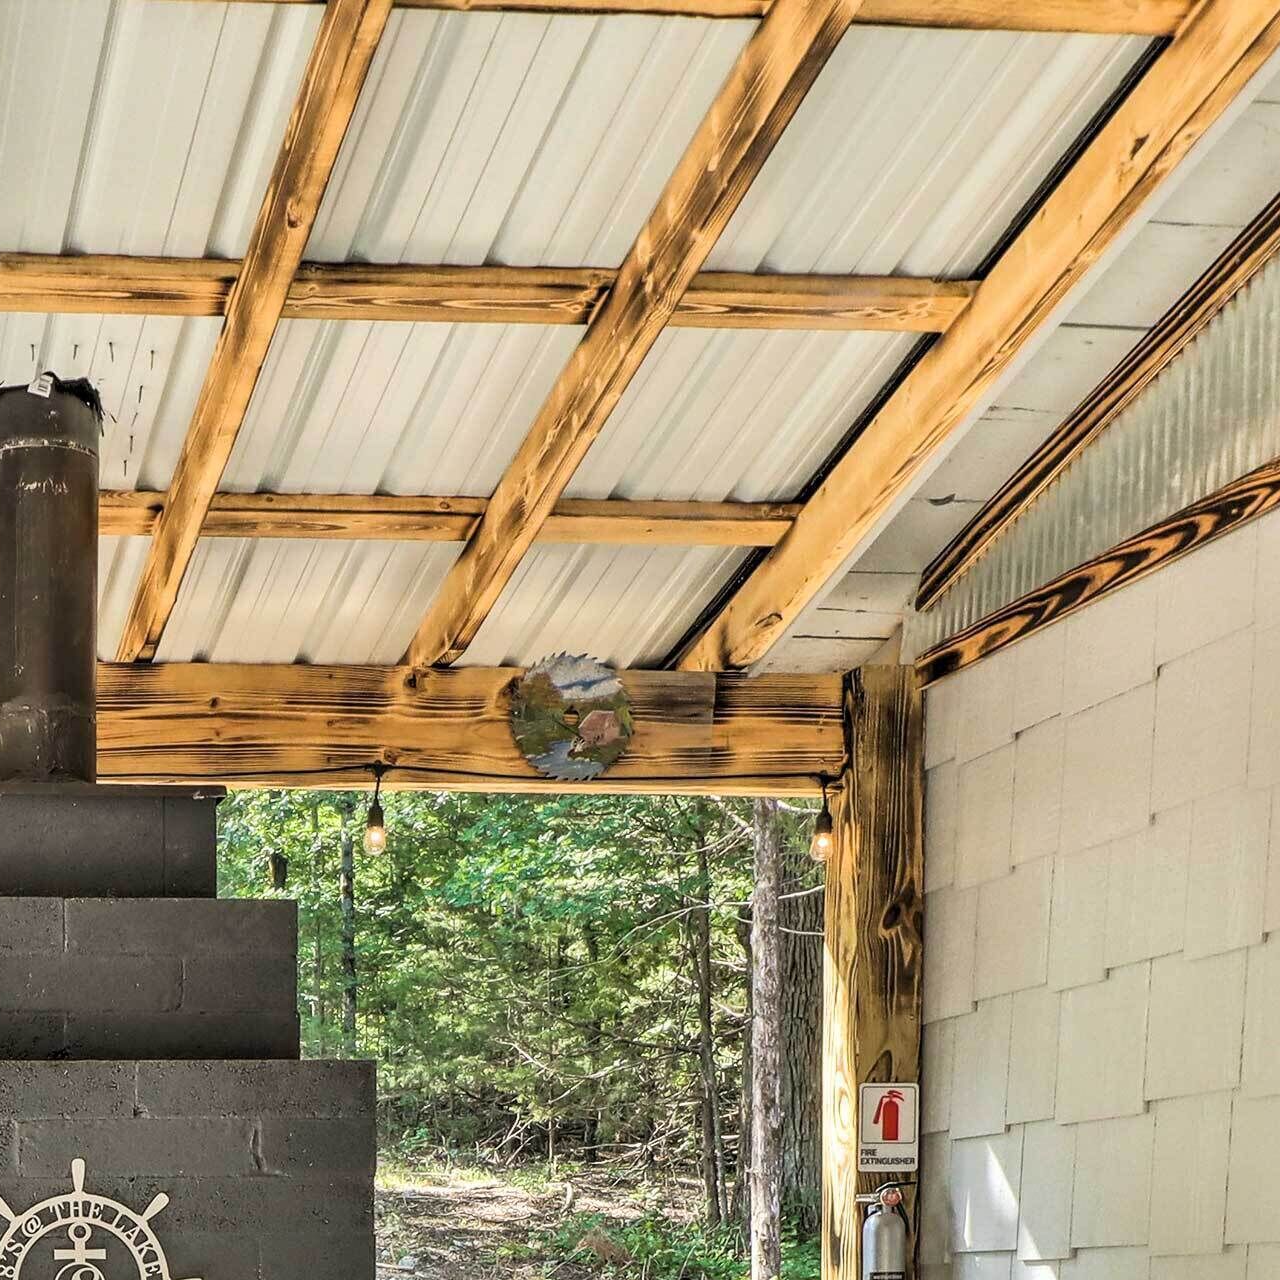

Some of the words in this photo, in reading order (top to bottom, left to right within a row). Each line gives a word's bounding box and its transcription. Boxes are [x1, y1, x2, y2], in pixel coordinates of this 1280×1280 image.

[860, 1157, 915, 1165] EXTINGUISHER
[22, 1215, 44, 1238] @
[50, 1200, 104, 1221] THE
[111, 1210, 162, 1277] LAKE
